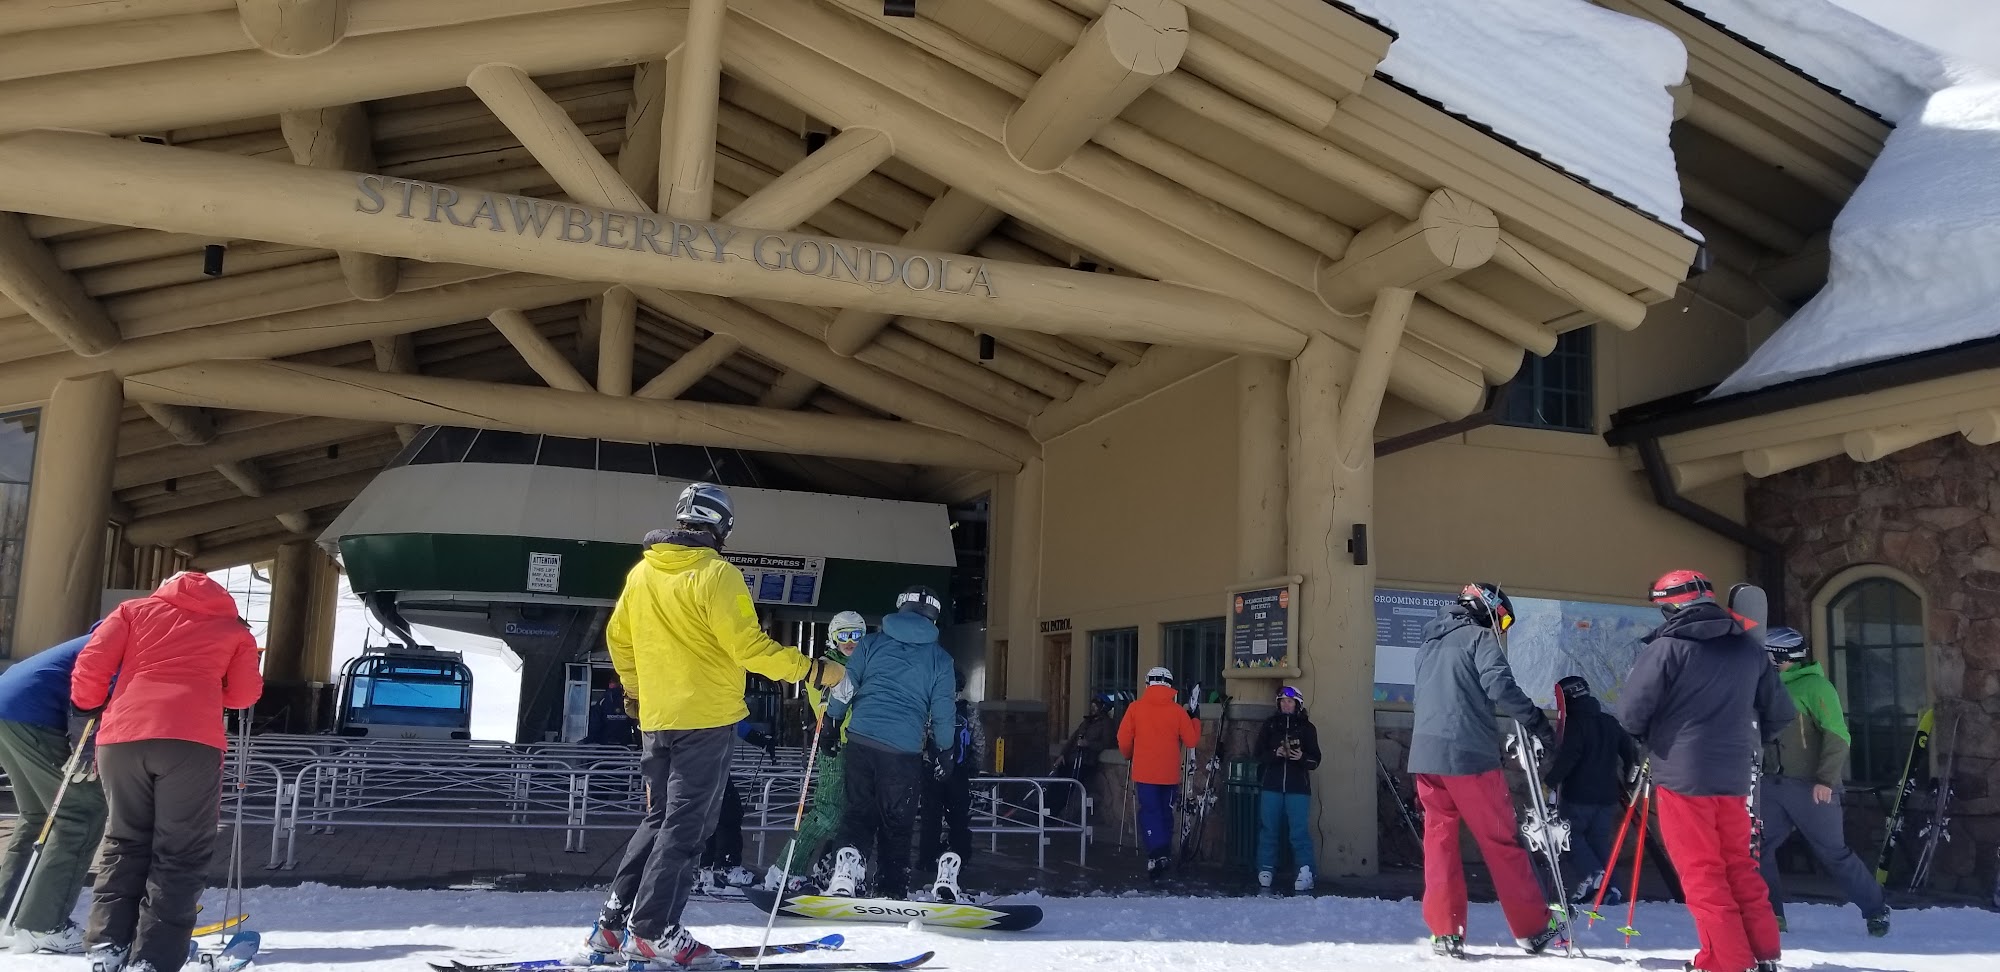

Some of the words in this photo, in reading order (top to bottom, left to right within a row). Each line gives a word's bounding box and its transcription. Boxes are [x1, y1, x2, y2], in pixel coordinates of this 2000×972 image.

[356, 175, 739, 263] STRAWBERRY
[753, 234, 998, 299] GONDOLA
[533, 556, 558, 565] ATTENTION
[721, 556, 758, 564] WBERRY
[760, 558, 800, 567] EXPRESS
[1374, 595, 1421, 606] GROOMING
[1422, 598, 1456, 607] REPORT
[1050, 618, 1072, 631] PATROL
